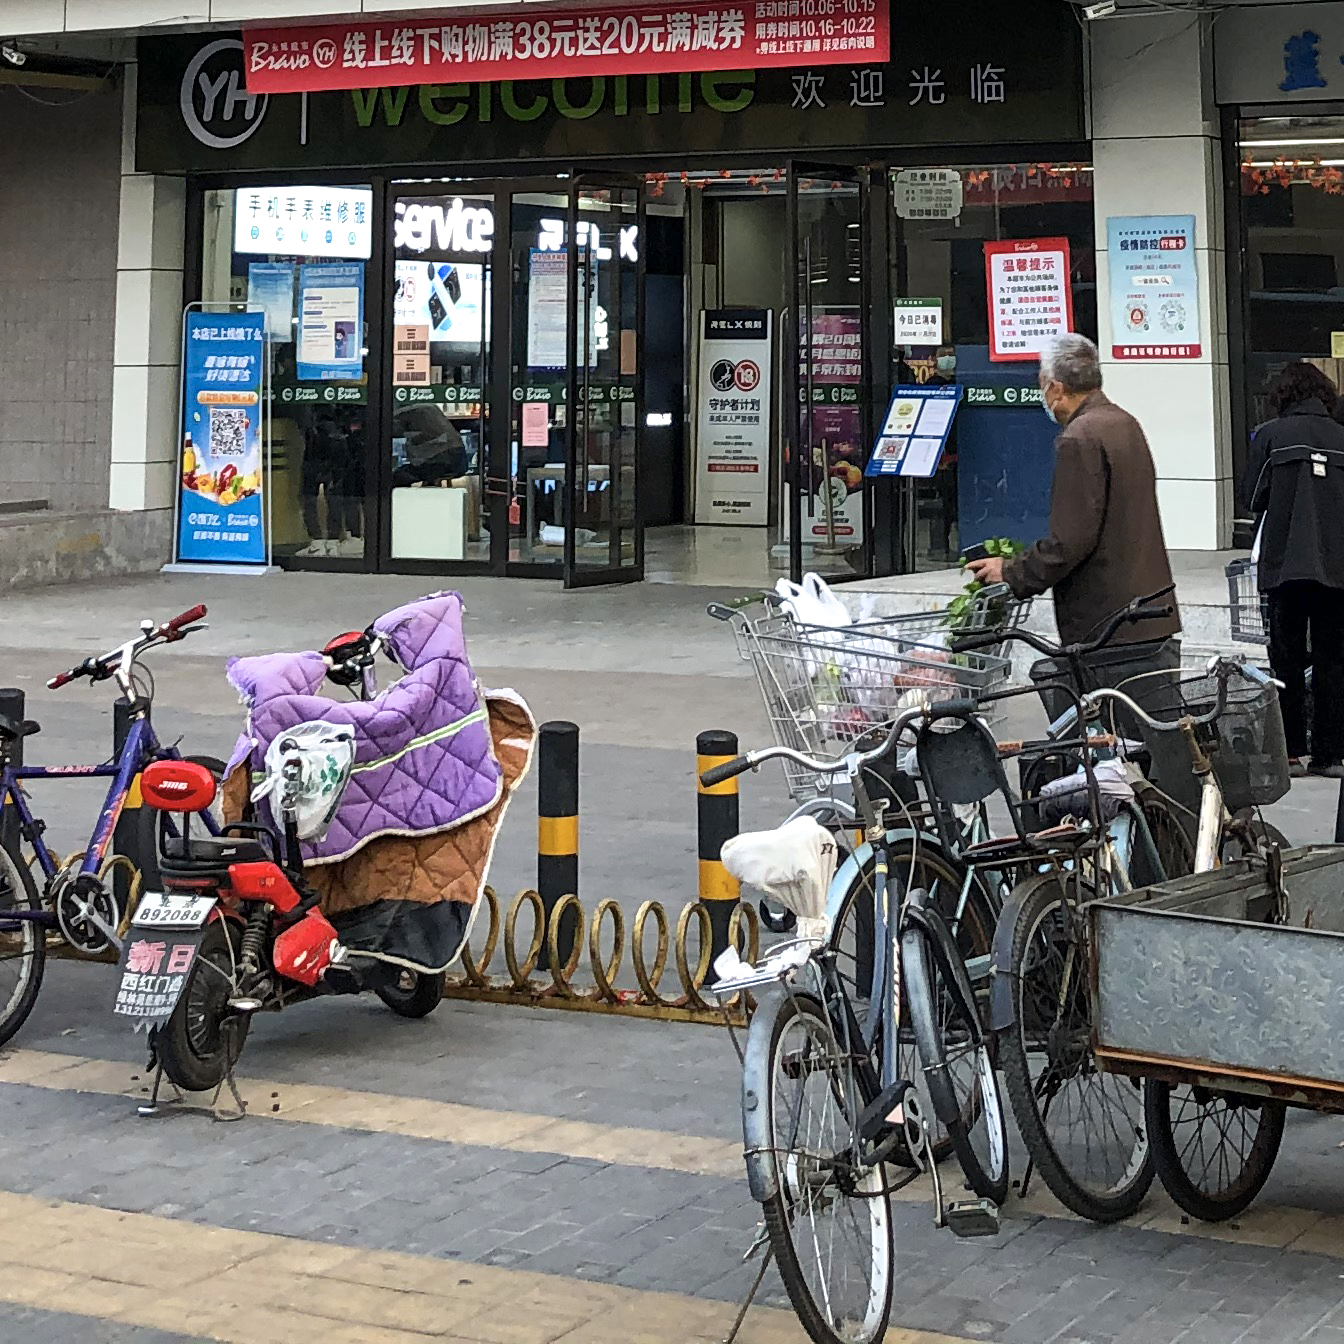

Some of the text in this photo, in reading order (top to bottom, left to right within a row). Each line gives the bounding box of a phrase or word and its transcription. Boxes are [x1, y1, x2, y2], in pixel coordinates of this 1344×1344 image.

[342, 9, 745, 69] 线上线下购物满38元送20元满减券
[755, 16, 876, 39] 用券时间10.16-10.22
[250, 42, 311, 72] Bravo
[792, 63, 1006, 109] 欢迎光临
[1003, 257, 1055, 272] 温馨提示
[709, 398, 760, 411] 守护者计划
[140, 908, 202, 921] 892088
[126, 939, 197, 974] 新日
